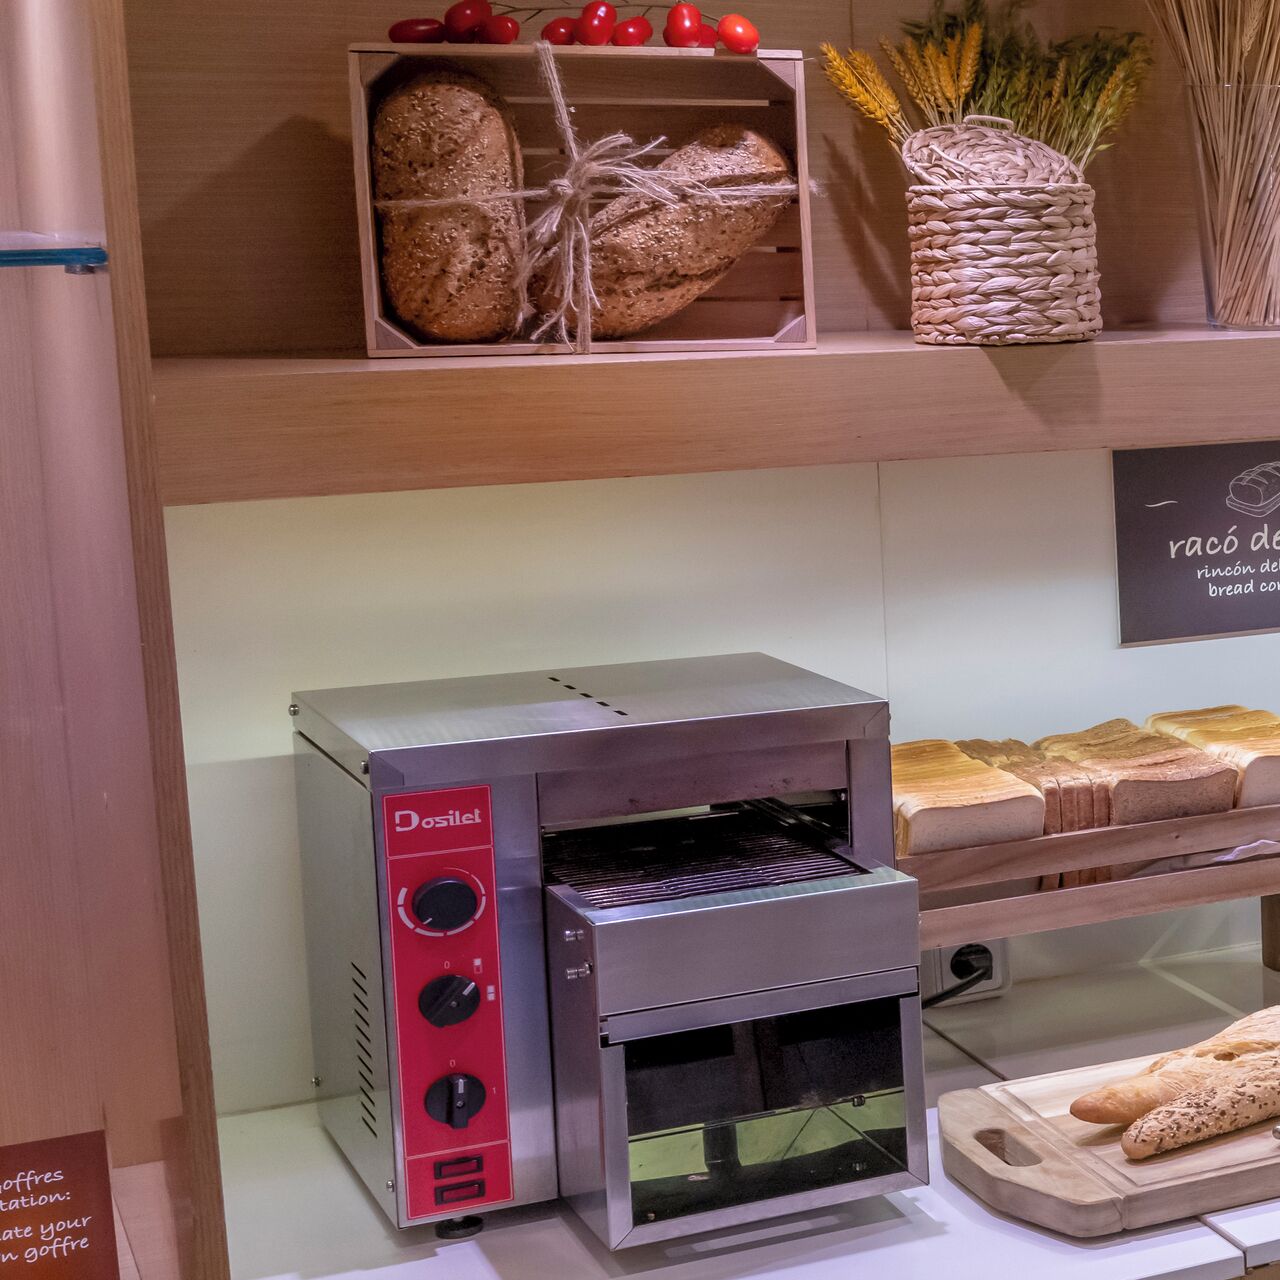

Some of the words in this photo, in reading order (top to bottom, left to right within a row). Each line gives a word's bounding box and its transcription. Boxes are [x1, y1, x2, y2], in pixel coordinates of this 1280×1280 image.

[1168, 524, 1239, 559] racó
[1197, 560, 1255, 580] rincón
[1208, 579, 1254, 598] bread
[394, 808, 482, 833] Dosilet
[0, 1169, 65, 1194] offres
[0, 1191, 71, 1212] tation:
[0, 1225, 33, 1241] ate
[40, 1215, 93, 1241] your
[24, 1235, 90, 1264] goffre
